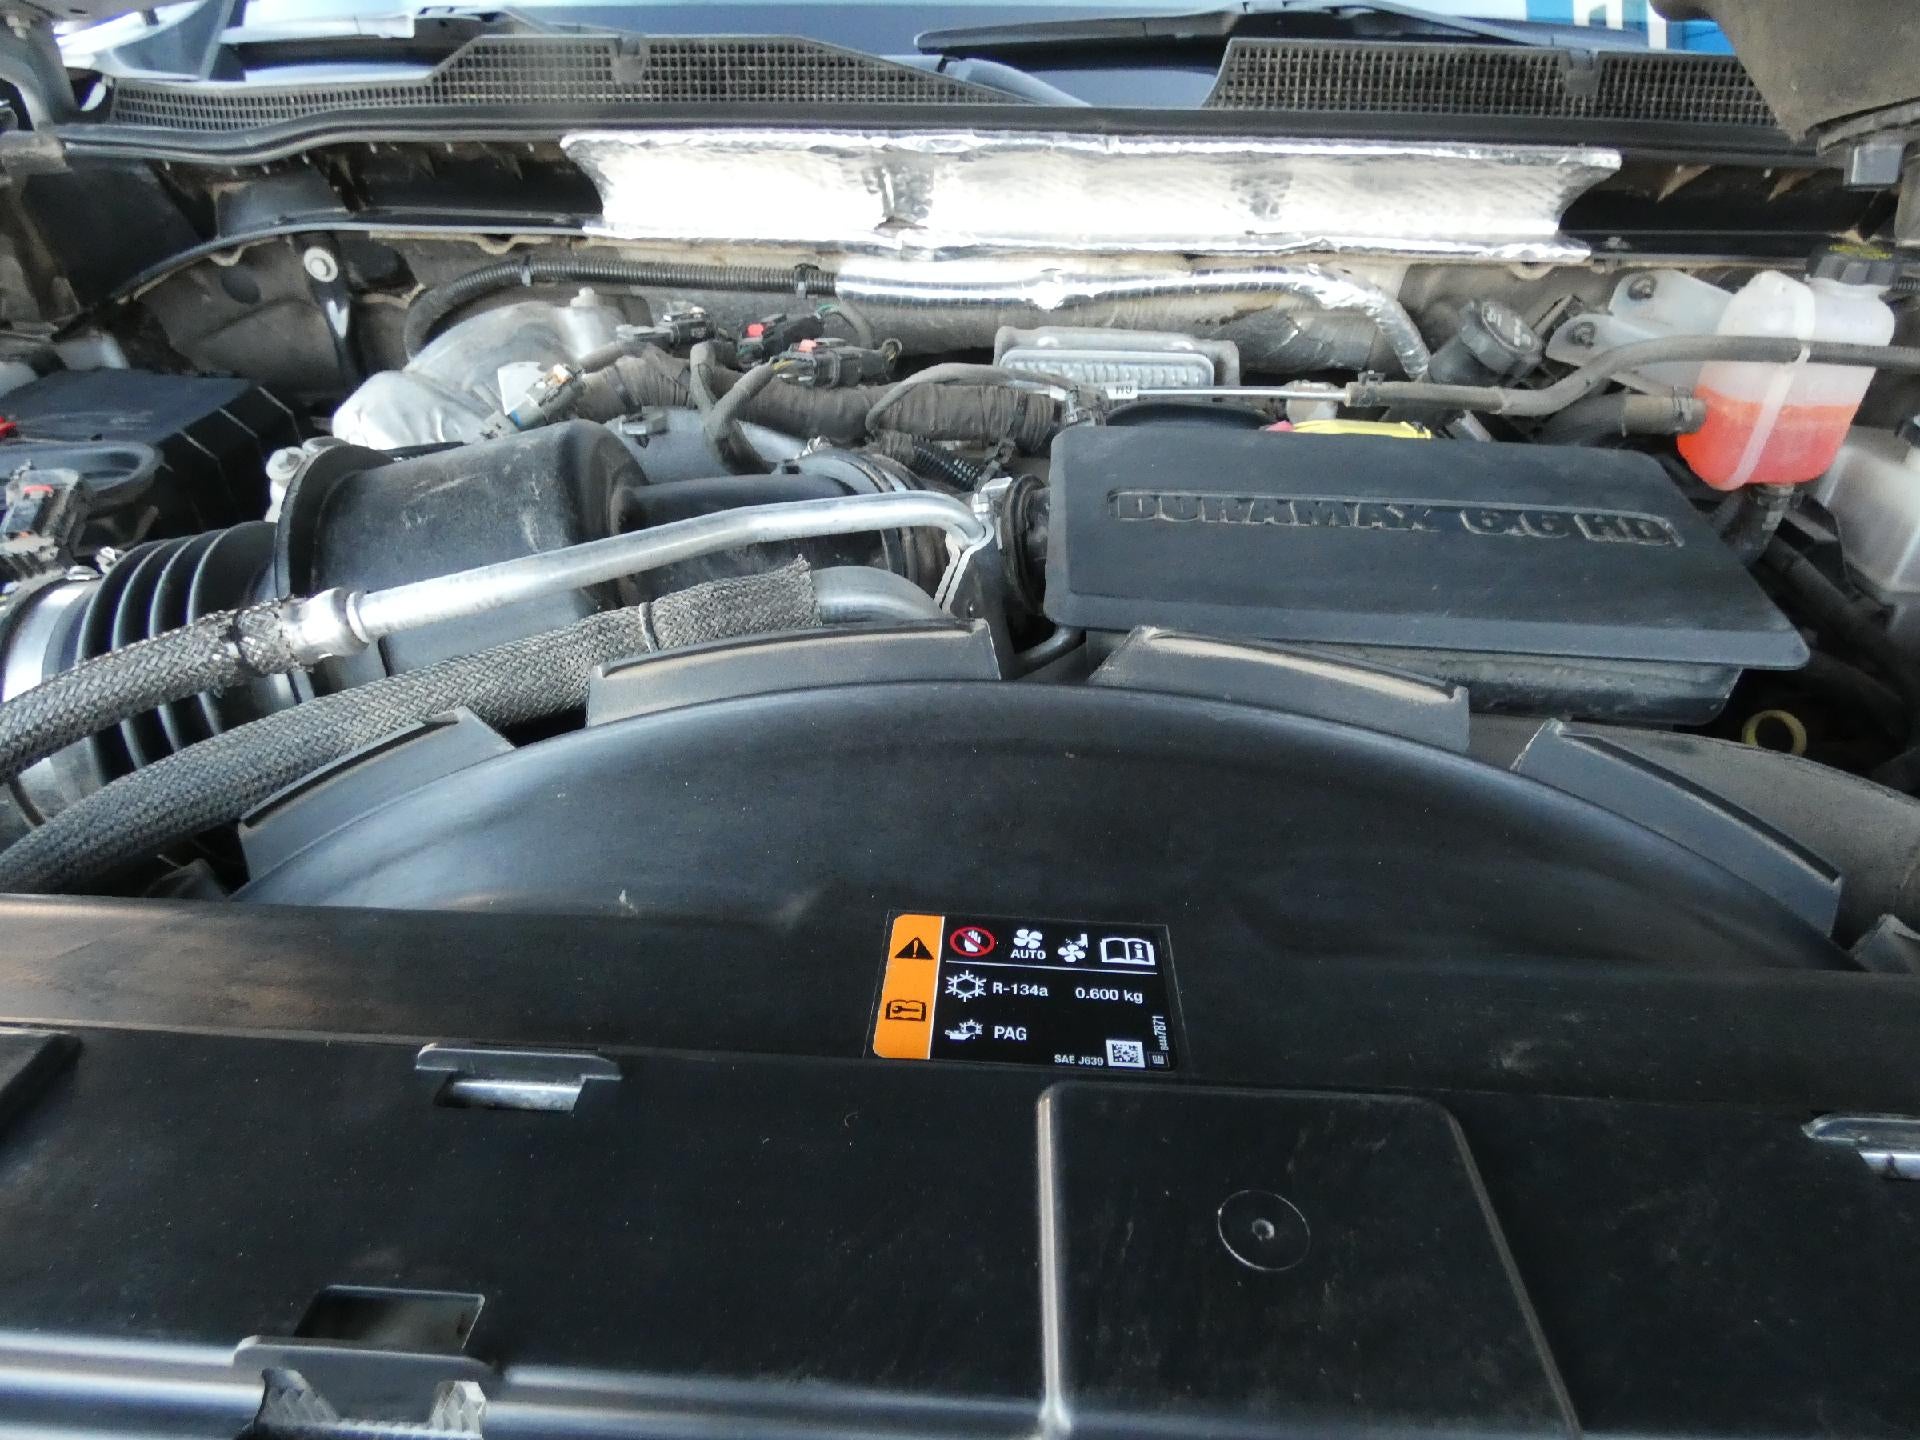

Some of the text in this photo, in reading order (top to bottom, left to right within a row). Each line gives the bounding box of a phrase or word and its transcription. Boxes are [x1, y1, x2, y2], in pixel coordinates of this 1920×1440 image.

[1114, 492, 1436, 530] DURAMAX
[1010, 949, 1047, 960] AUTO
[992, 981, 1143, 1004] R-134a 0.600 kg
[994, 1025, 1027, 1041] PAG
[1054, 1054, 1104, 1066] SAE J639
